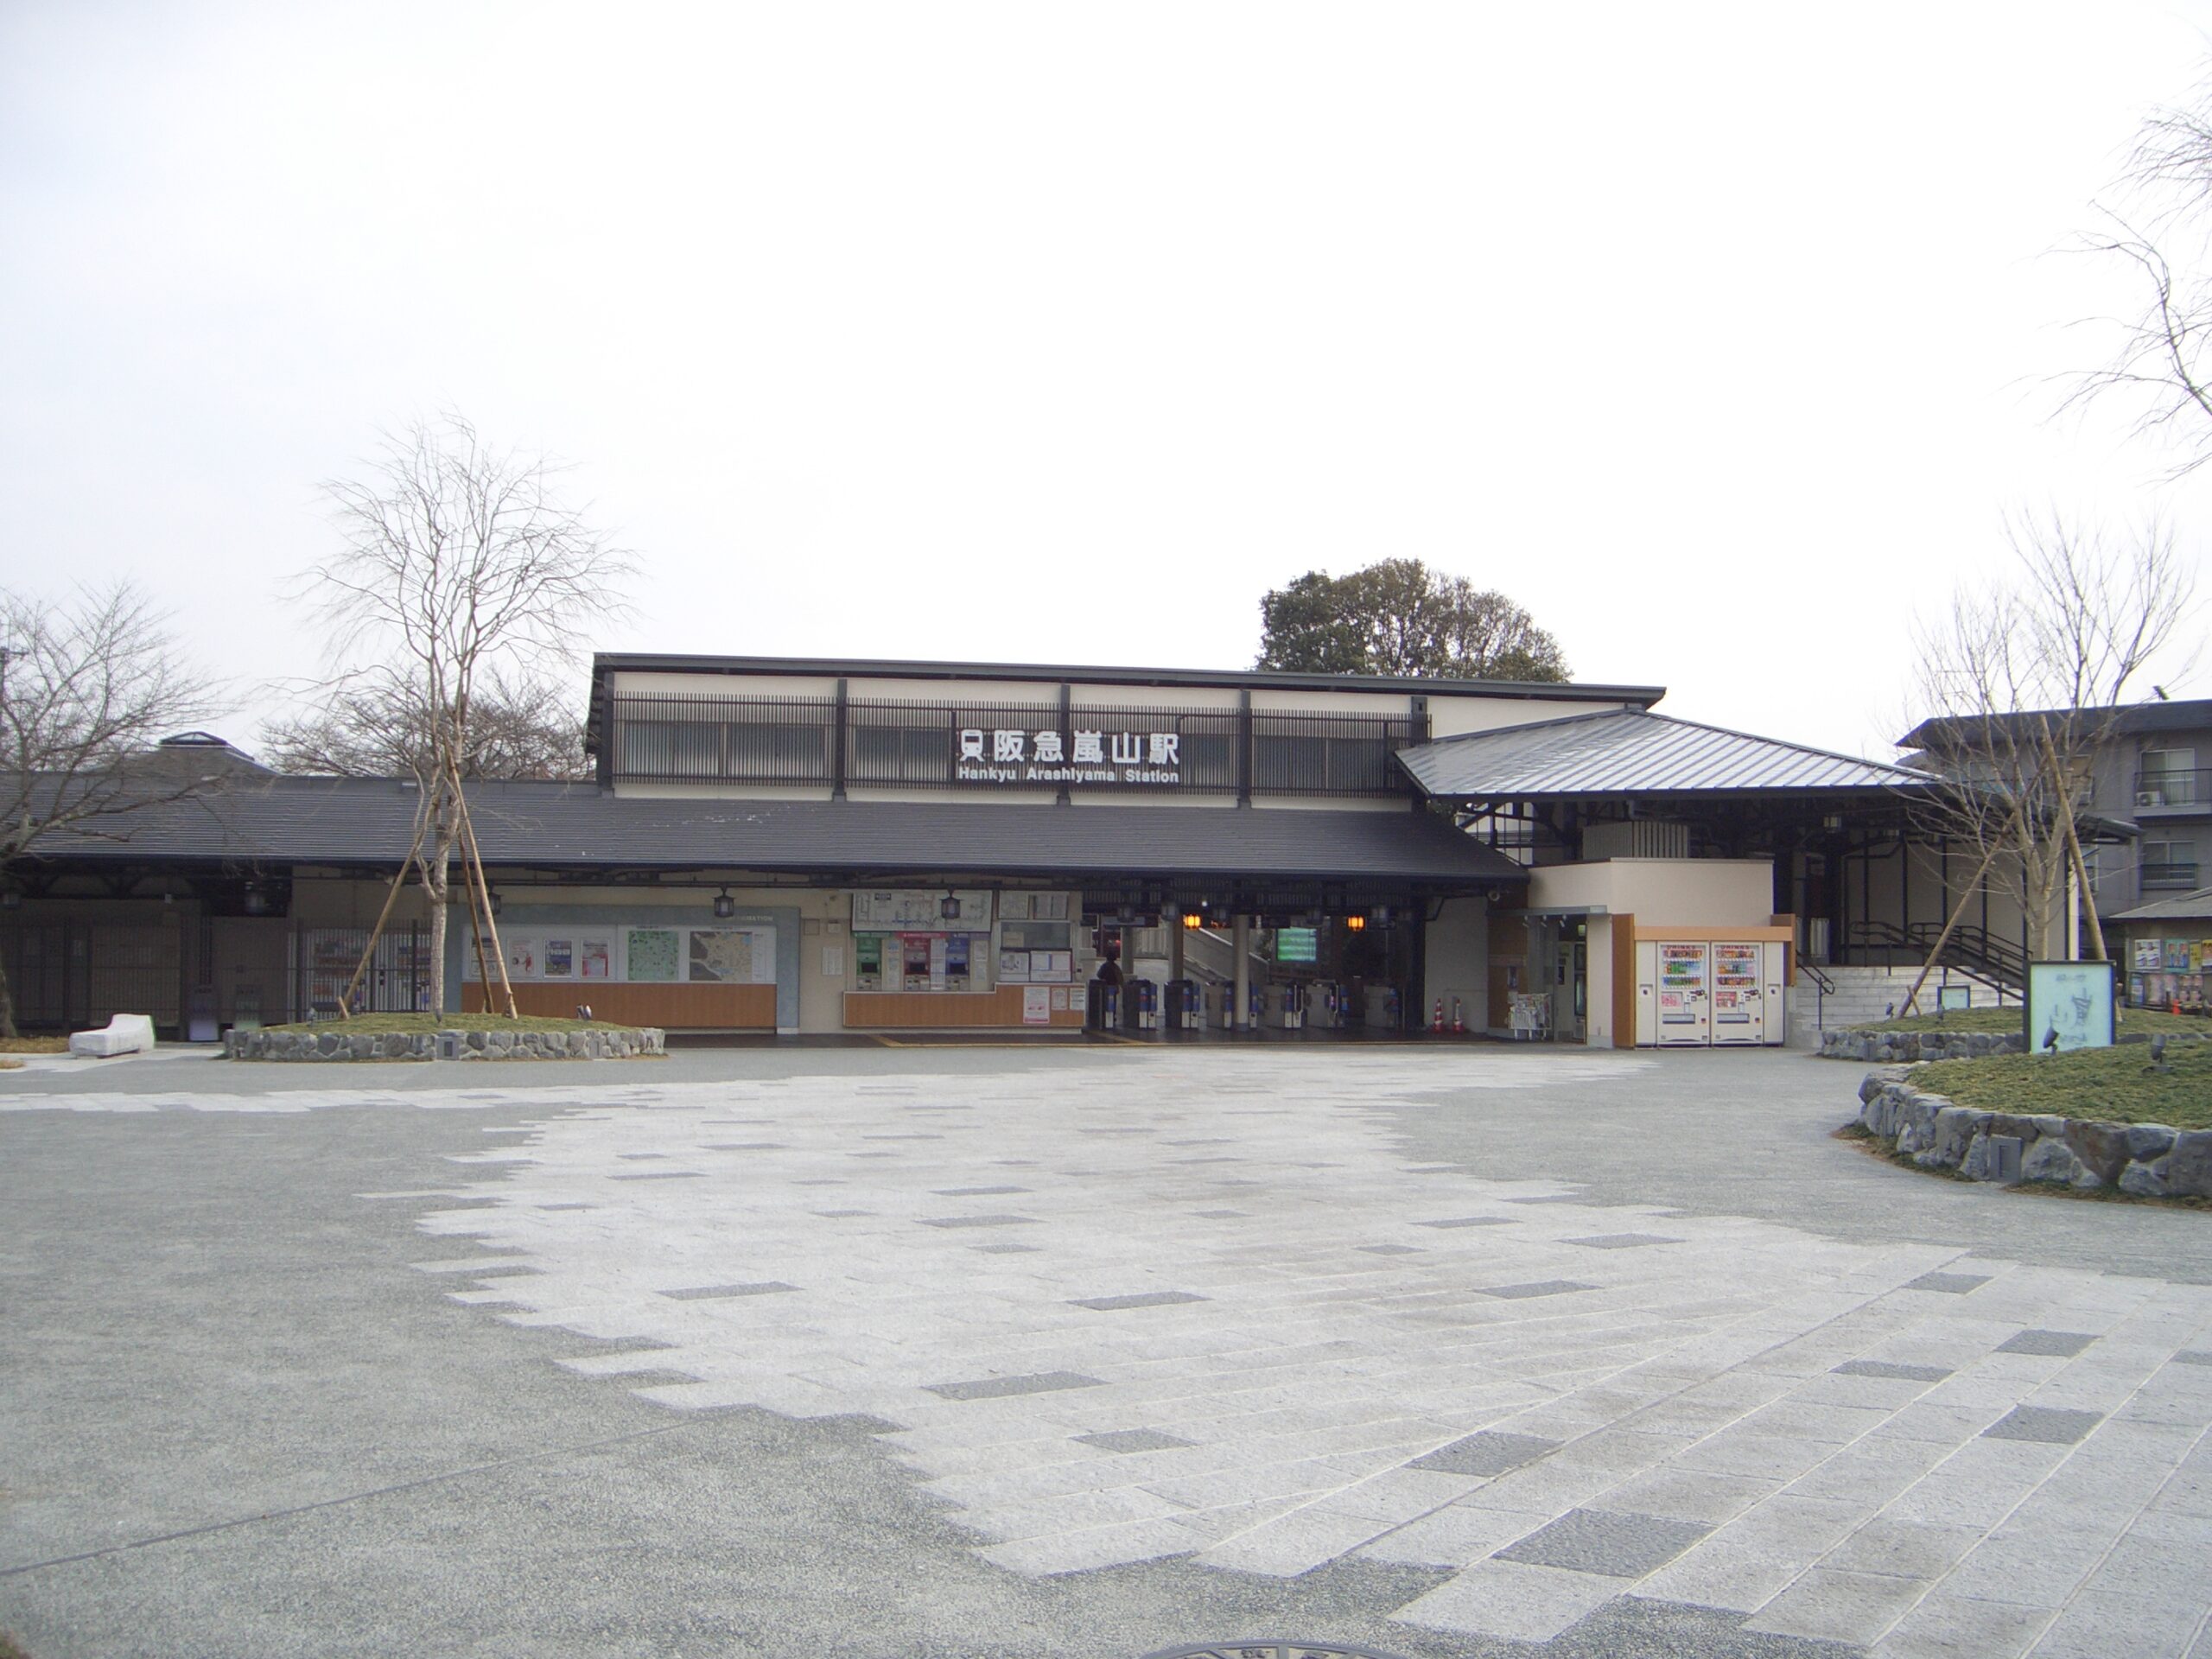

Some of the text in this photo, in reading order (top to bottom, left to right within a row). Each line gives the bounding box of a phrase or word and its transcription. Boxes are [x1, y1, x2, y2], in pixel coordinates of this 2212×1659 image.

[994, 729, 1179, 765] 阪急嵐山駅
[958, 766, 1179, 784] Hankyu Arashiyama Station
